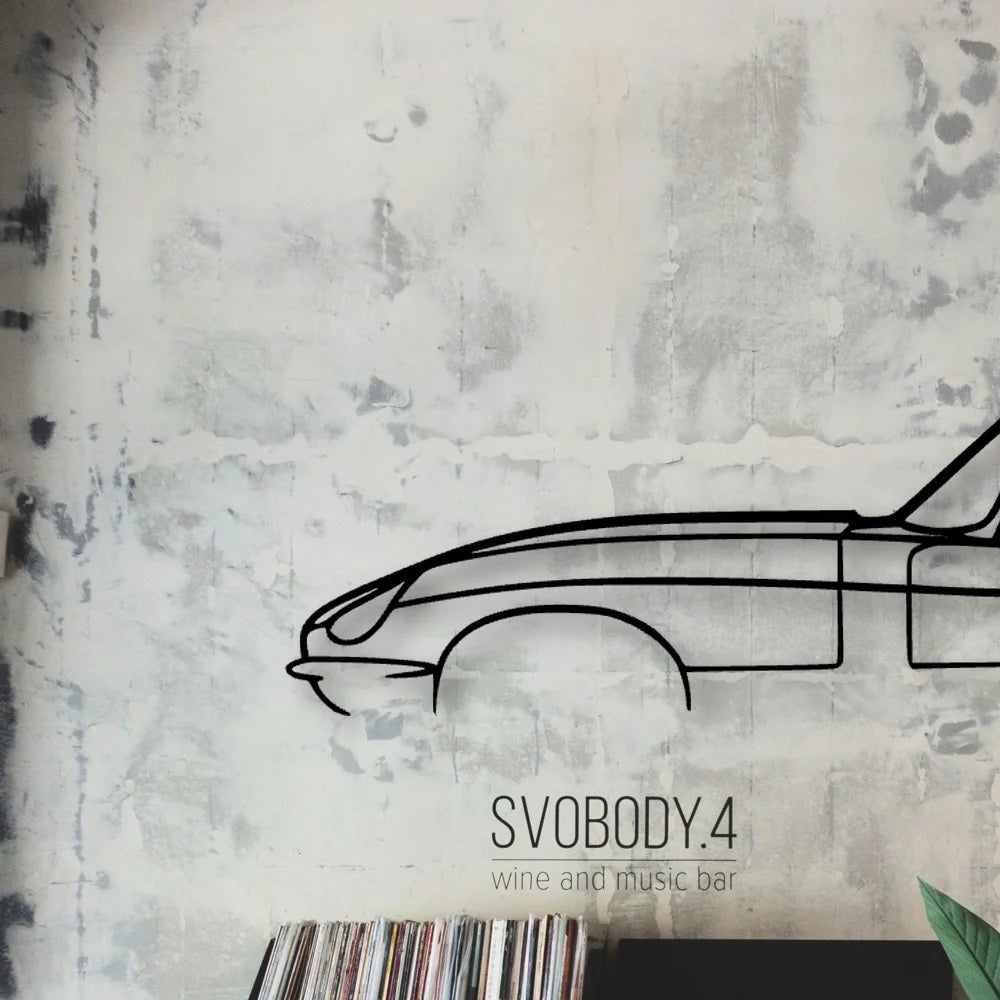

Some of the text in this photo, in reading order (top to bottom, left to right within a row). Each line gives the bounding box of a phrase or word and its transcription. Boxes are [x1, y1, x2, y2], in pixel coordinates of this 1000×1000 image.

[491, 795, 738, 849] SVOBODY.4
[491, 866, 737, 891] wine and music bar
